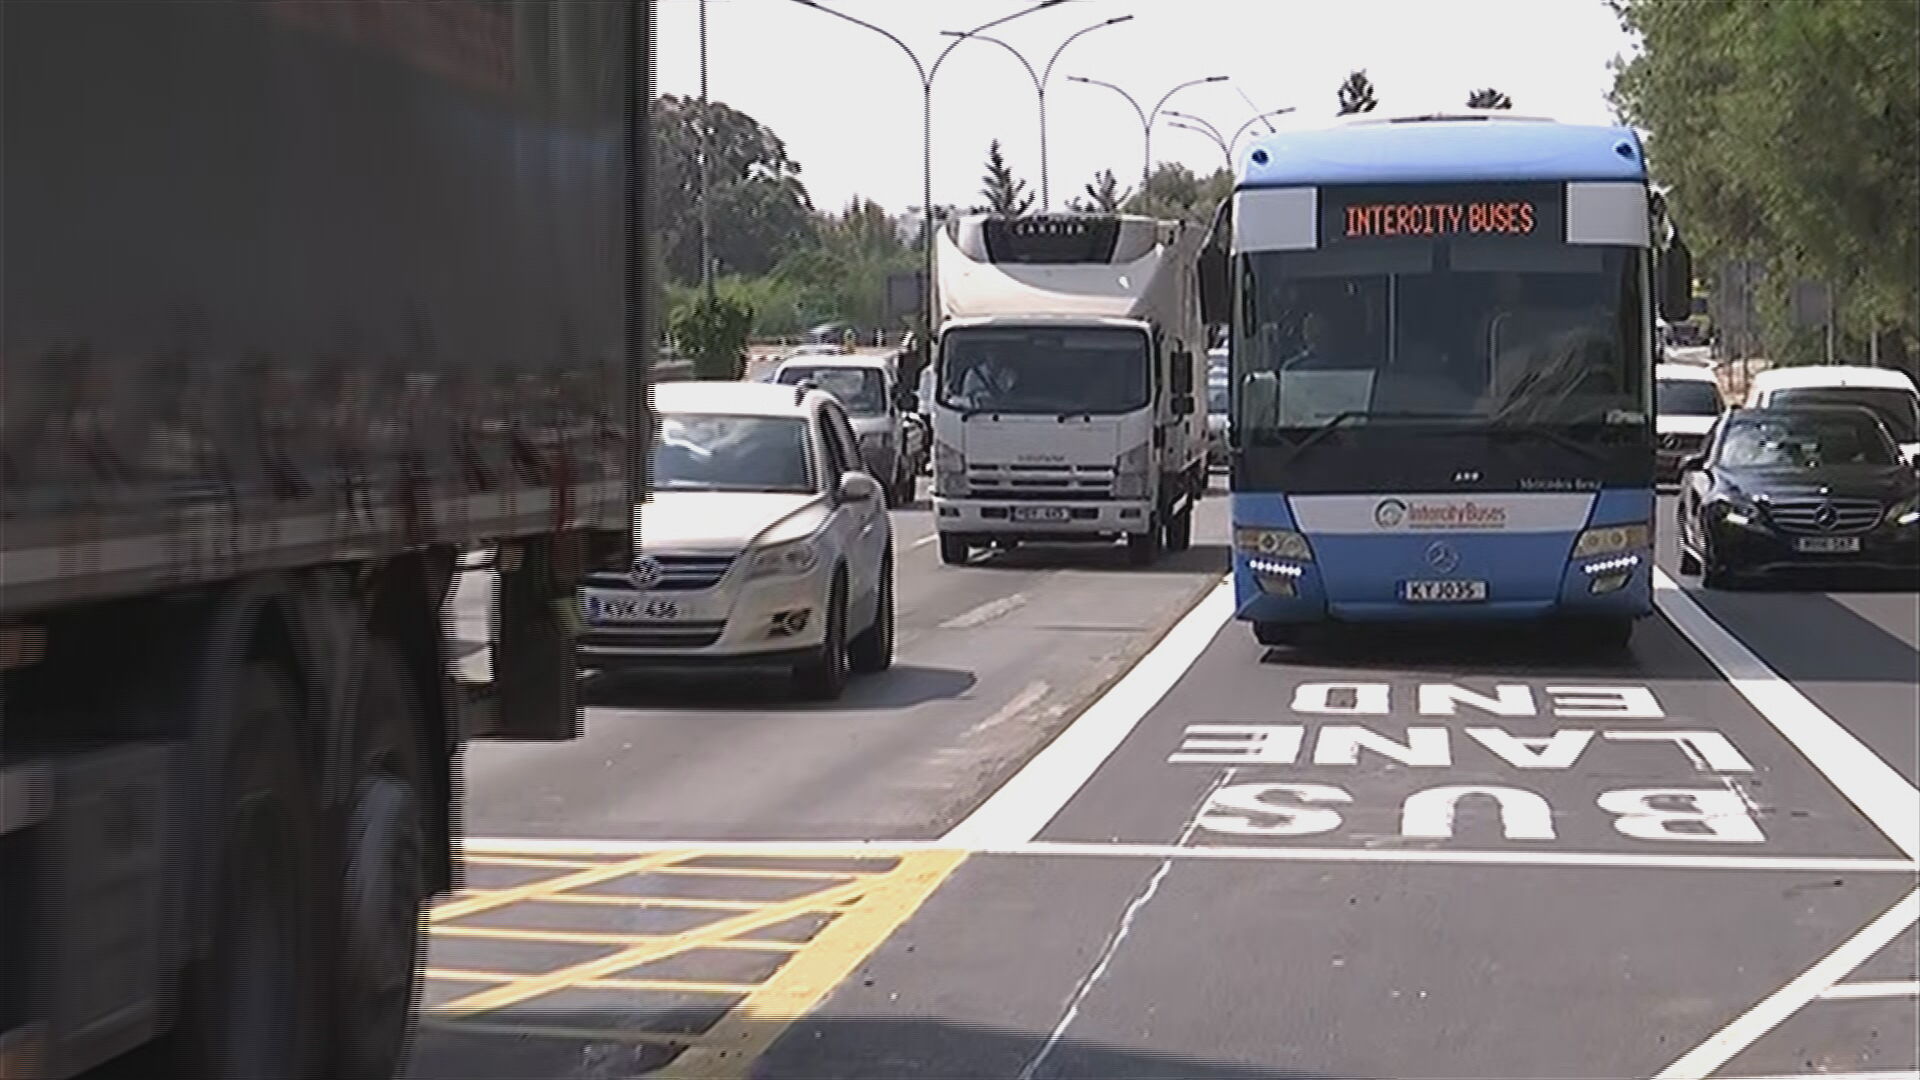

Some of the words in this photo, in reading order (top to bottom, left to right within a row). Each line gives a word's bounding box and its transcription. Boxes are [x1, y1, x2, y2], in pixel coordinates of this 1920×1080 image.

[1345, 204, 1464, 237] INTERCITY
[1468, 202, 1535, 233] BUSES
[1290, 683, 1666, 717] END
[1167, 724, 1755, 771] LANE
[1198, 784, 1767, 842] BUS
